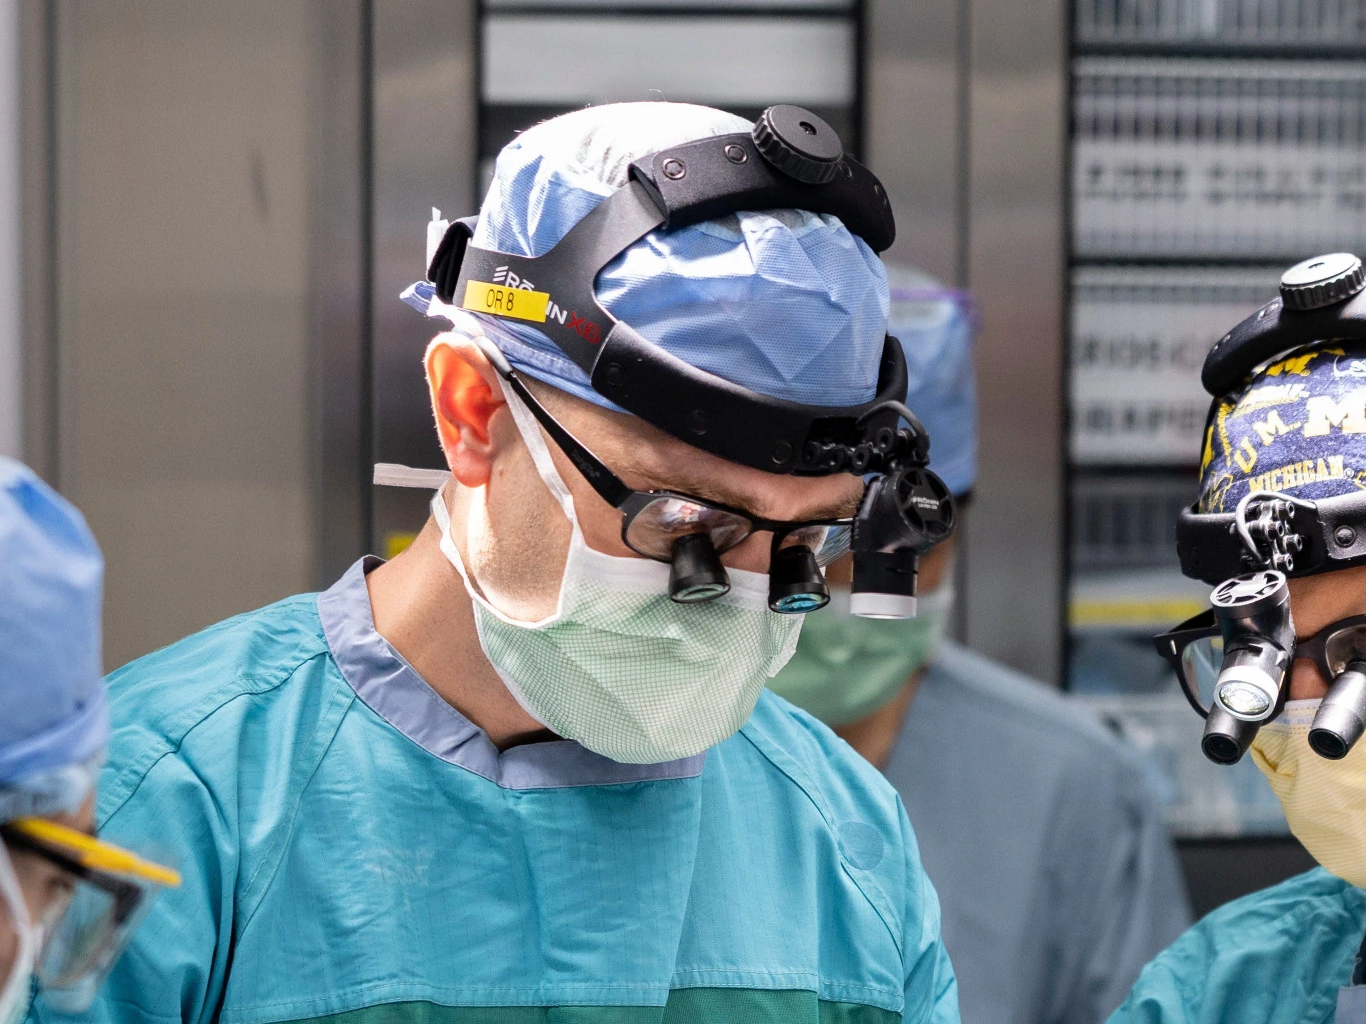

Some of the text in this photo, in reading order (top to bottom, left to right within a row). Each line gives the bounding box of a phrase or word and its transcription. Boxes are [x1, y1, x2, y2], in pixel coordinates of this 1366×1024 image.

[486, 289, 515, 311] OR 8
[566, 311, 601, 344] X6
[1253, 409, 1286, 446] M
[1249, 454, 1344, 493] MICHIGAN
